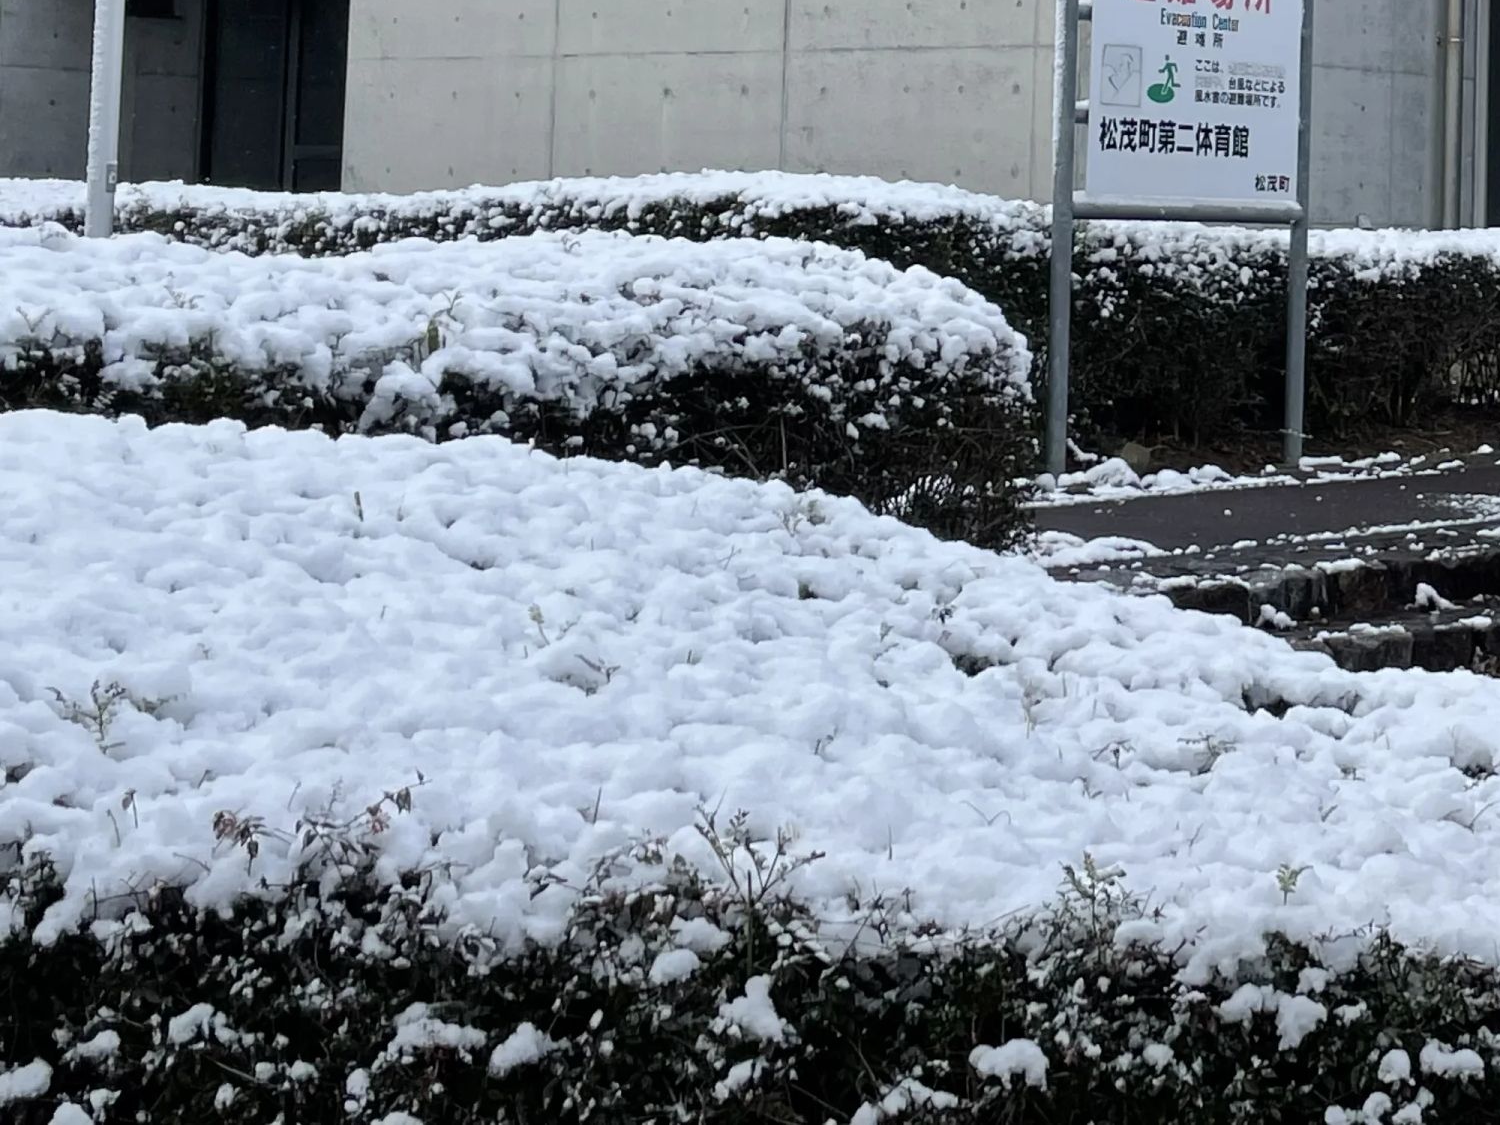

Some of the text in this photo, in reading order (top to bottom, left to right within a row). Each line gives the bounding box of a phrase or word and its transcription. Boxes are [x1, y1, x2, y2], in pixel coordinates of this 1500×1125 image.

[1160, 7, 1239, 32] Evacuation Center
[1099, 116, 1250, 159] 松茂町第二体育館
[1254, 174, 1291, 194] 松茂町
